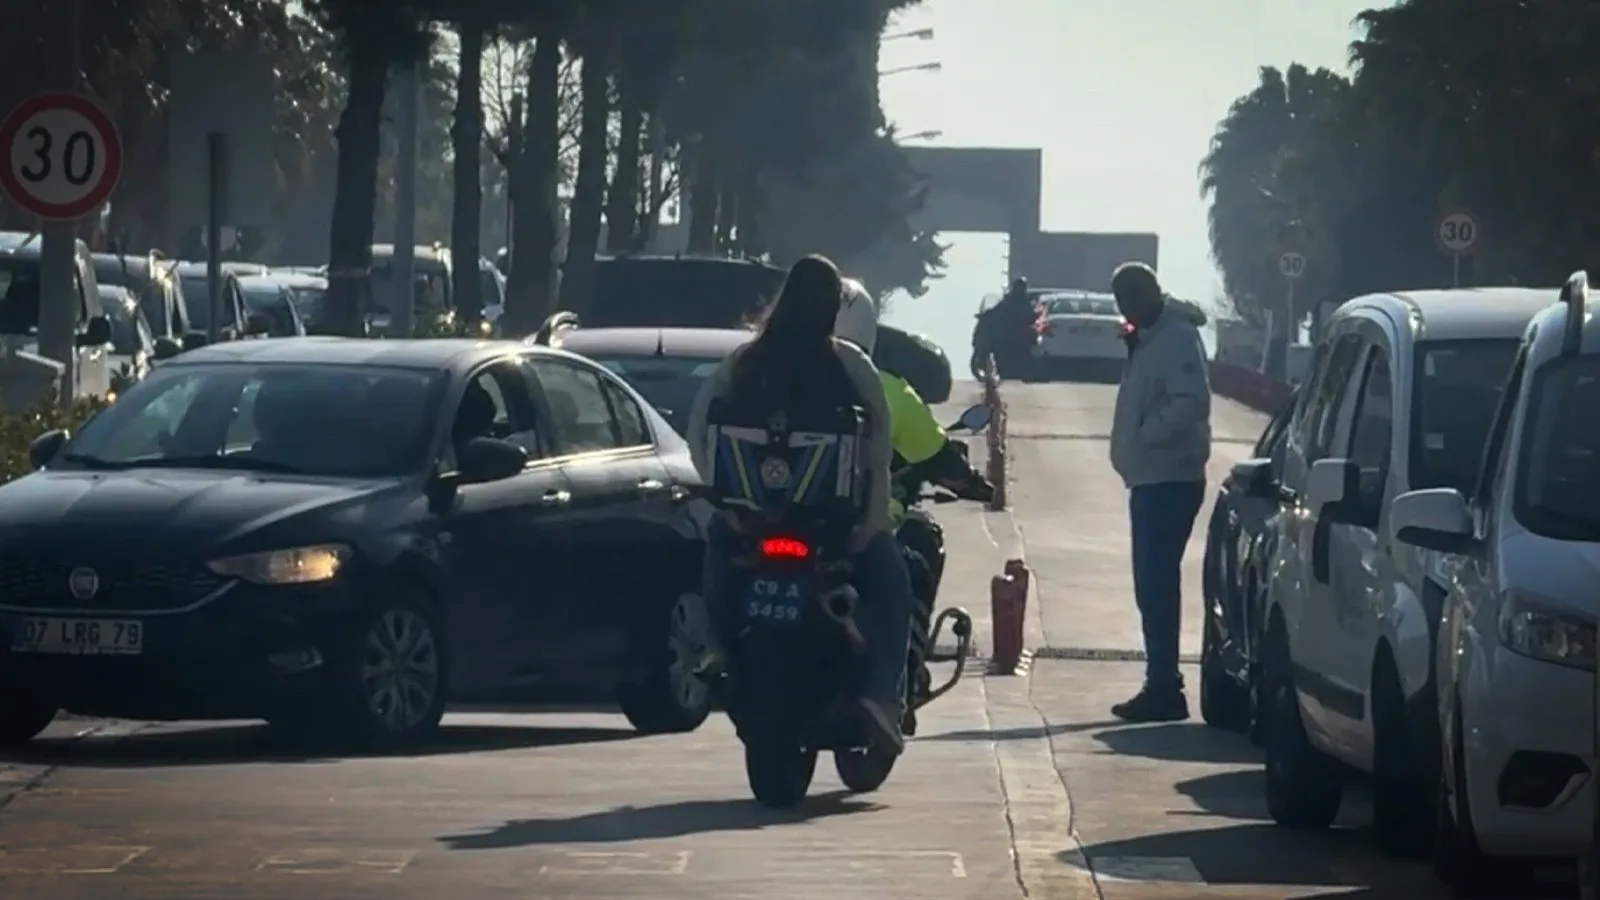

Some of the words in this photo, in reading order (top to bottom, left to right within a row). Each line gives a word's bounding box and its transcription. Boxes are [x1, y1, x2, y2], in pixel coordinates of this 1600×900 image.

[21, 126, 95, 186] 30
[1442, 221, 1473, 242] 30
[1281, 256, 1304, 275] 30
[784, 582, 800, 599] A
[24, 620, 49, 645] 07
[60, 621, 101, 646] LRG
[112, 621, 140, 646] 79
